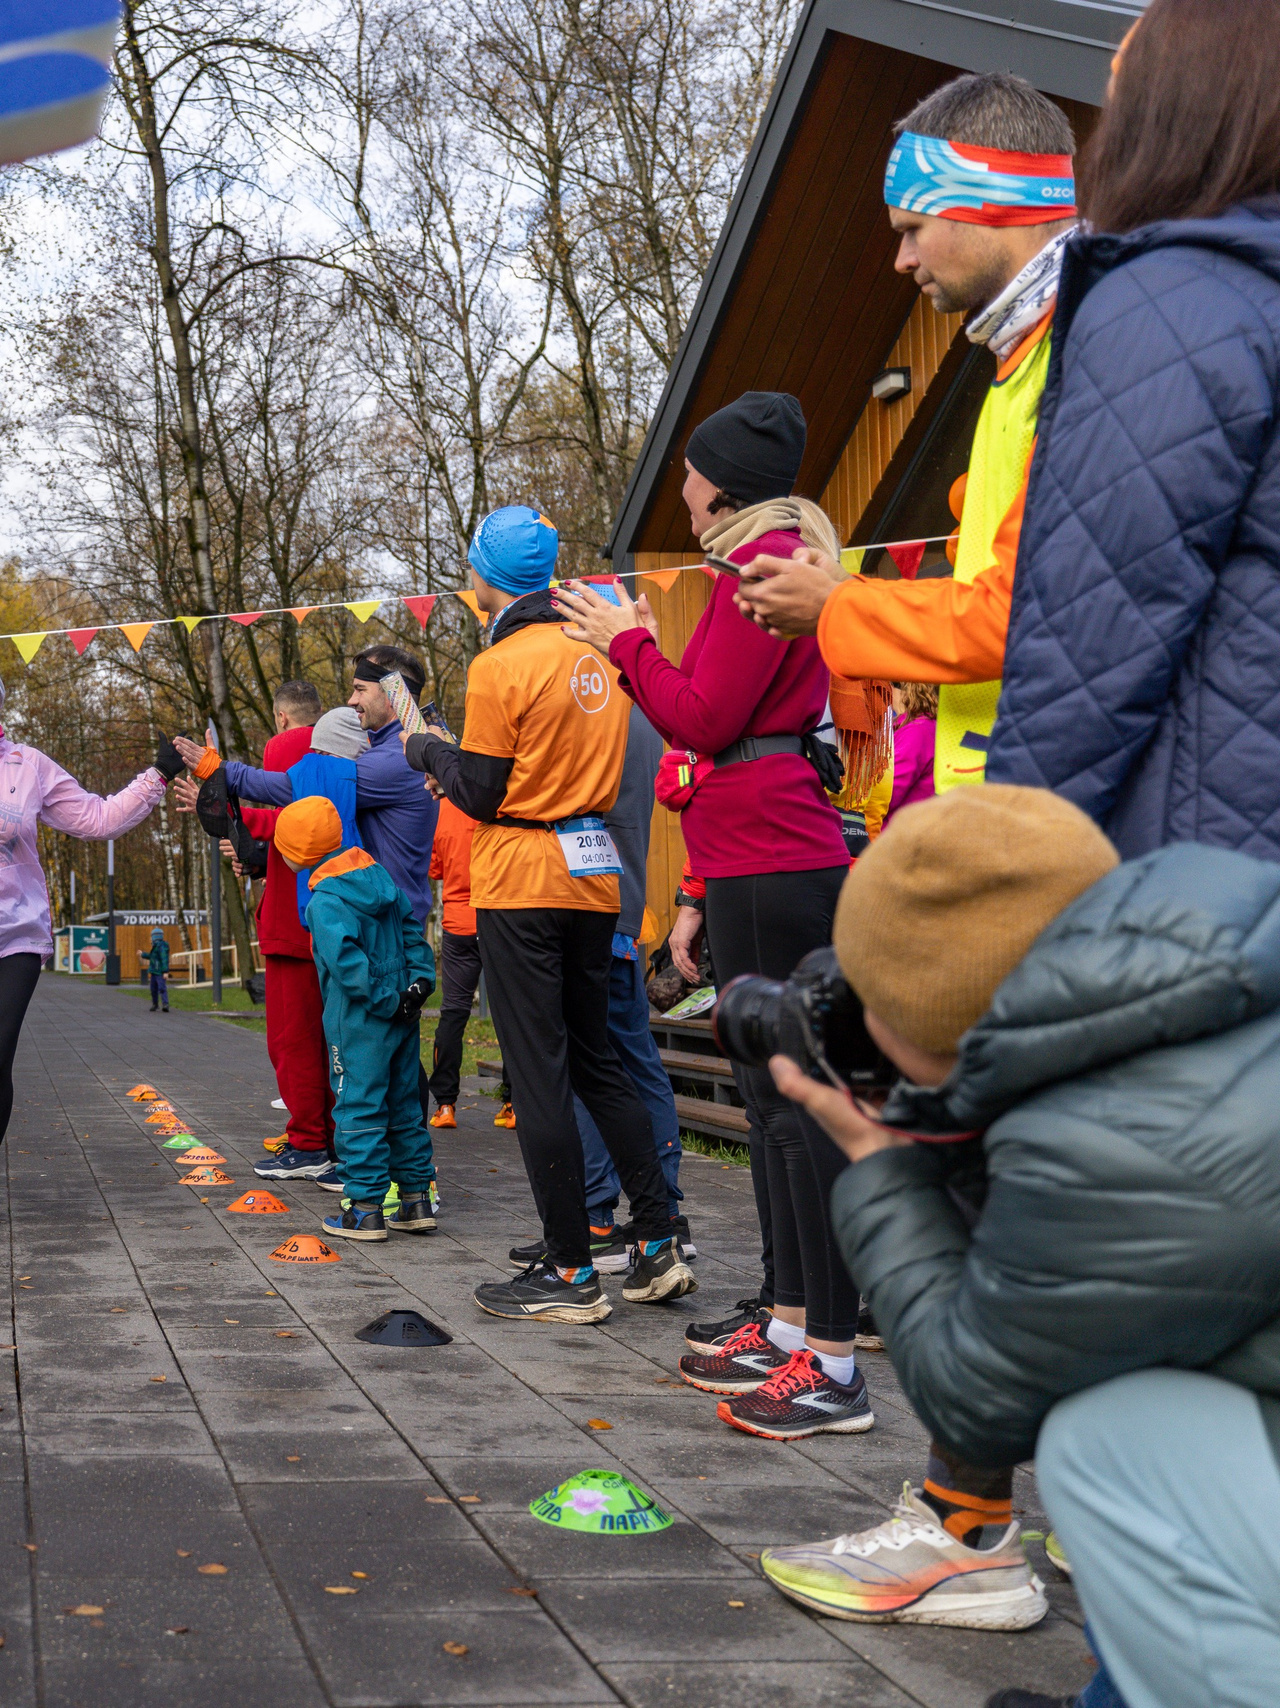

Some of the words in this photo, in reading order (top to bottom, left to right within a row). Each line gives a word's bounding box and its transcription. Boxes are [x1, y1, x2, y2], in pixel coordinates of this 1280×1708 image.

[581, 672, 603, 696] 50
[576, 835, 607, 848] 20:00
[581, 853, 605, 864] 04:00
[123, 915, 138, 925] 7D
